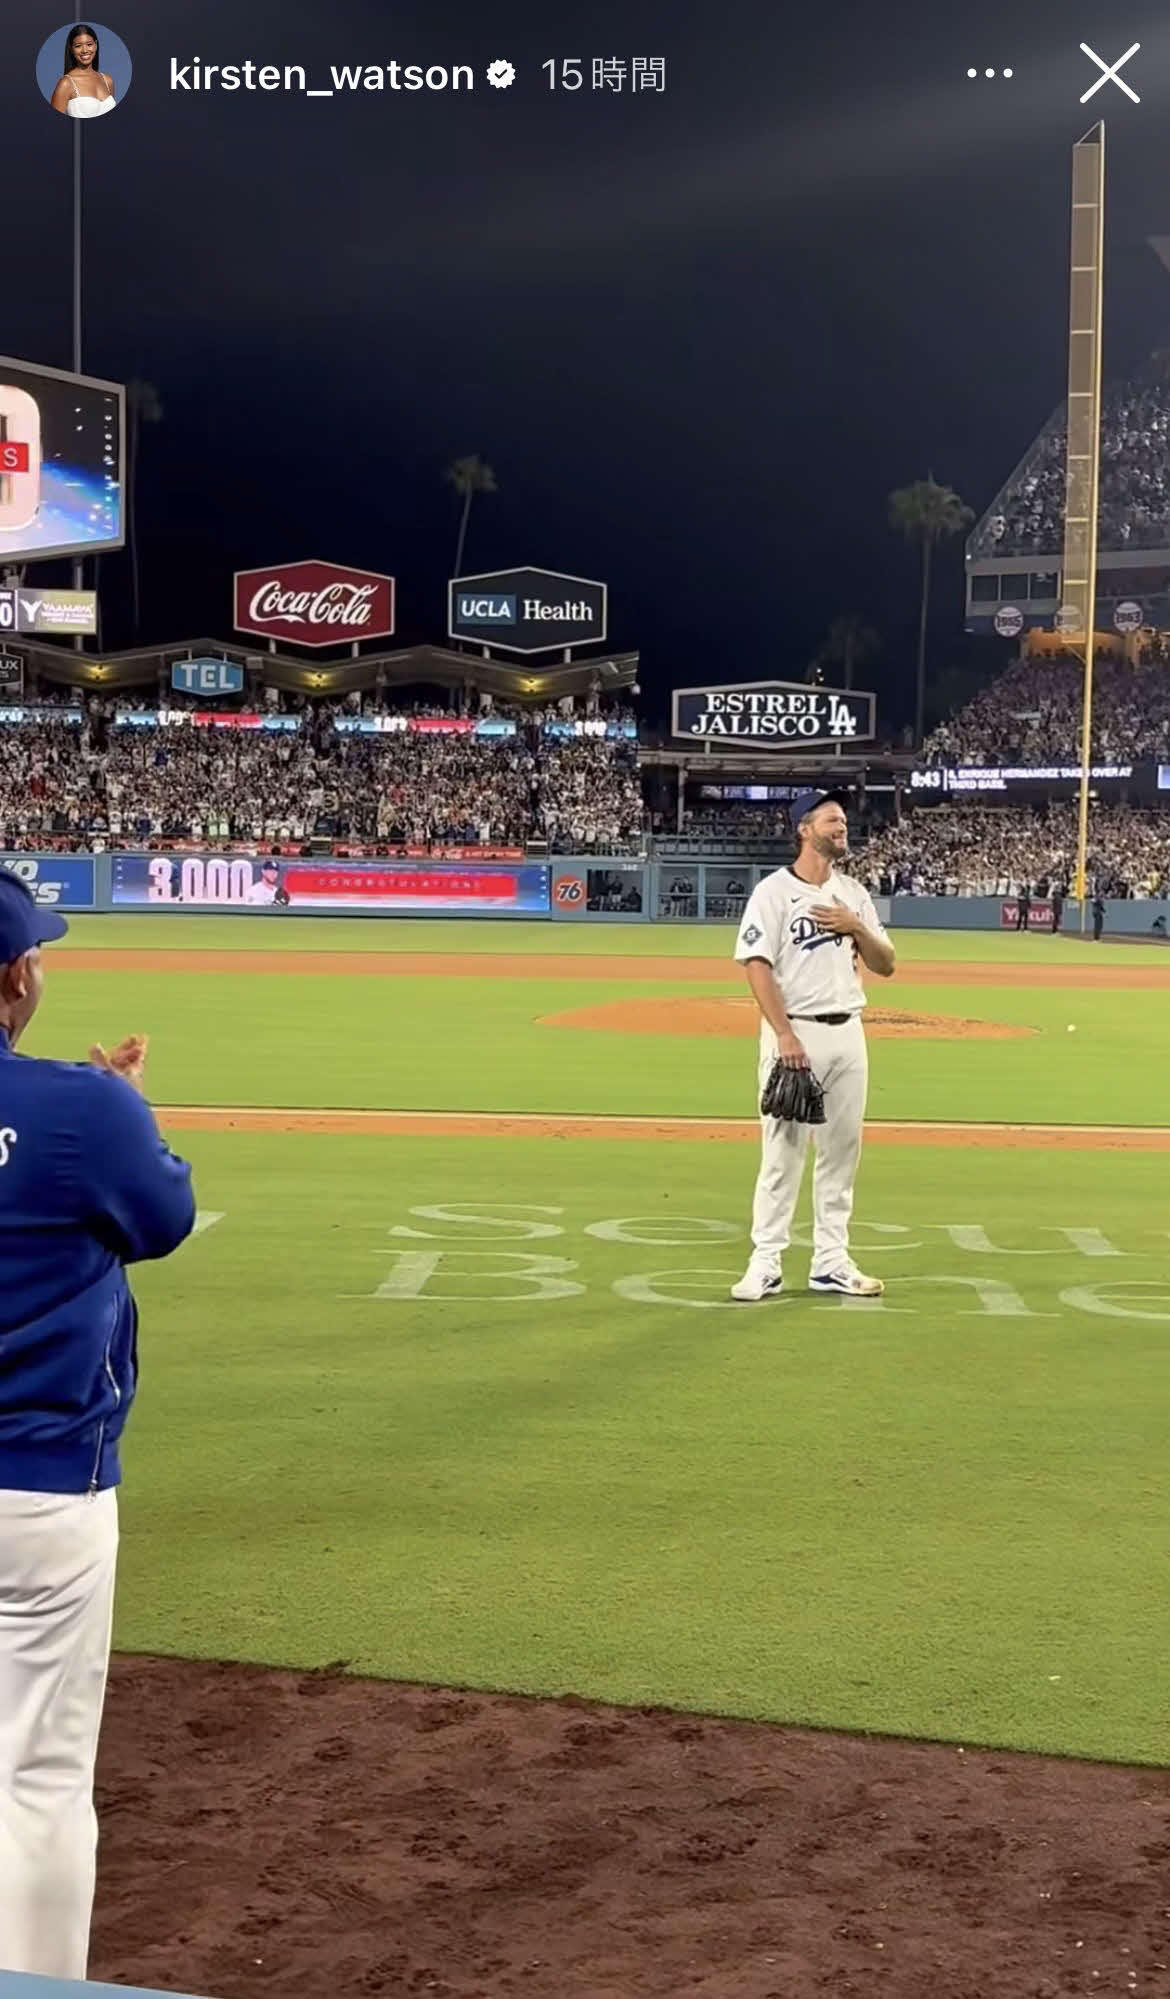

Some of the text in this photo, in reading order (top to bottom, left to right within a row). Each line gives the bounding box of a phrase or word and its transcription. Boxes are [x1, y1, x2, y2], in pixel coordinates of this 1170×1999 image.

[249, 581, 379, 625] Coca-Cola
[461, 599, 593, 621] UCLA Health
[181, 663, 235, 688] TEL
[691, 714, 821, 736] JALISCO
[559, 881, 583, 901] 76
